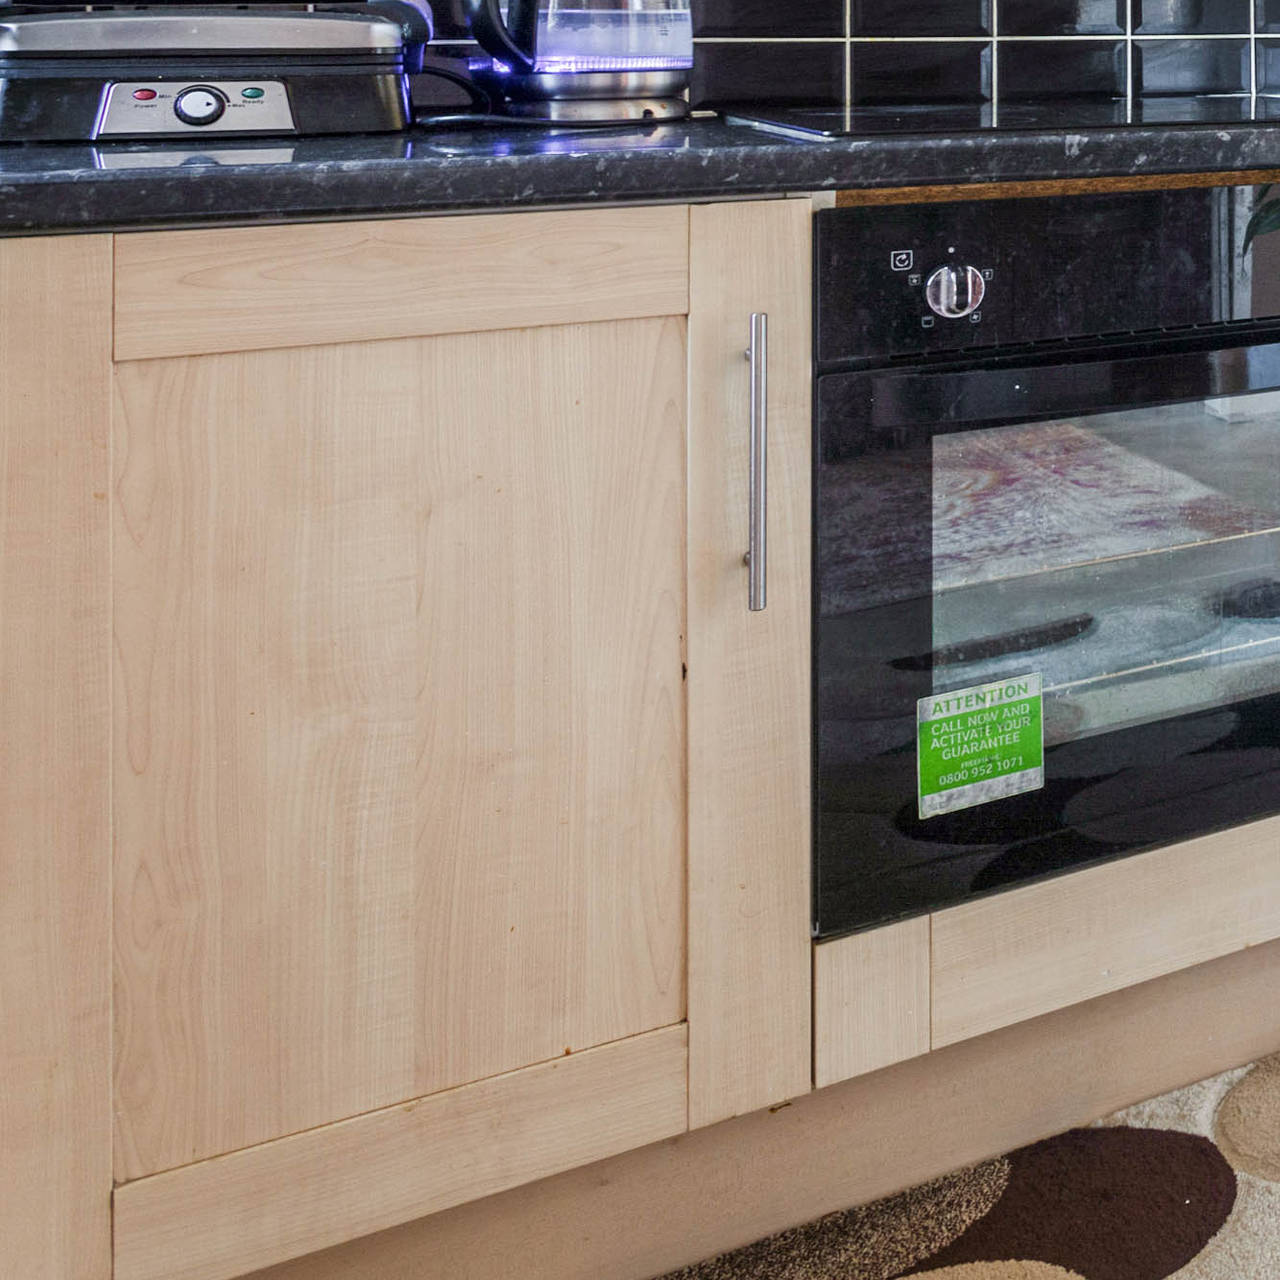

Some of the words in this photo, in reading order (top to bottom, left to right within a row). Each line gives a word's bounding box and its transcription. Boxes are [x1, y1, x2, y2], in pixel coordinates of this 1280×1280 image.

[932, 682, 1028, 716] ATTENTION
[931, 719, 964, 736] CALL
[968, 710, 999, 727] NOW
[1002, 703, 1030, 719] AND
[931, 725, 993, 750] ACTIVATE
[997, 716, 1031, 733] YOUR
[942, 732, 1020, 760] GUARANTEE
[939, 770, 969, 786] 0800
[971, 764, 993, 778] 952
[997, 756, 1024, 772] 1071
